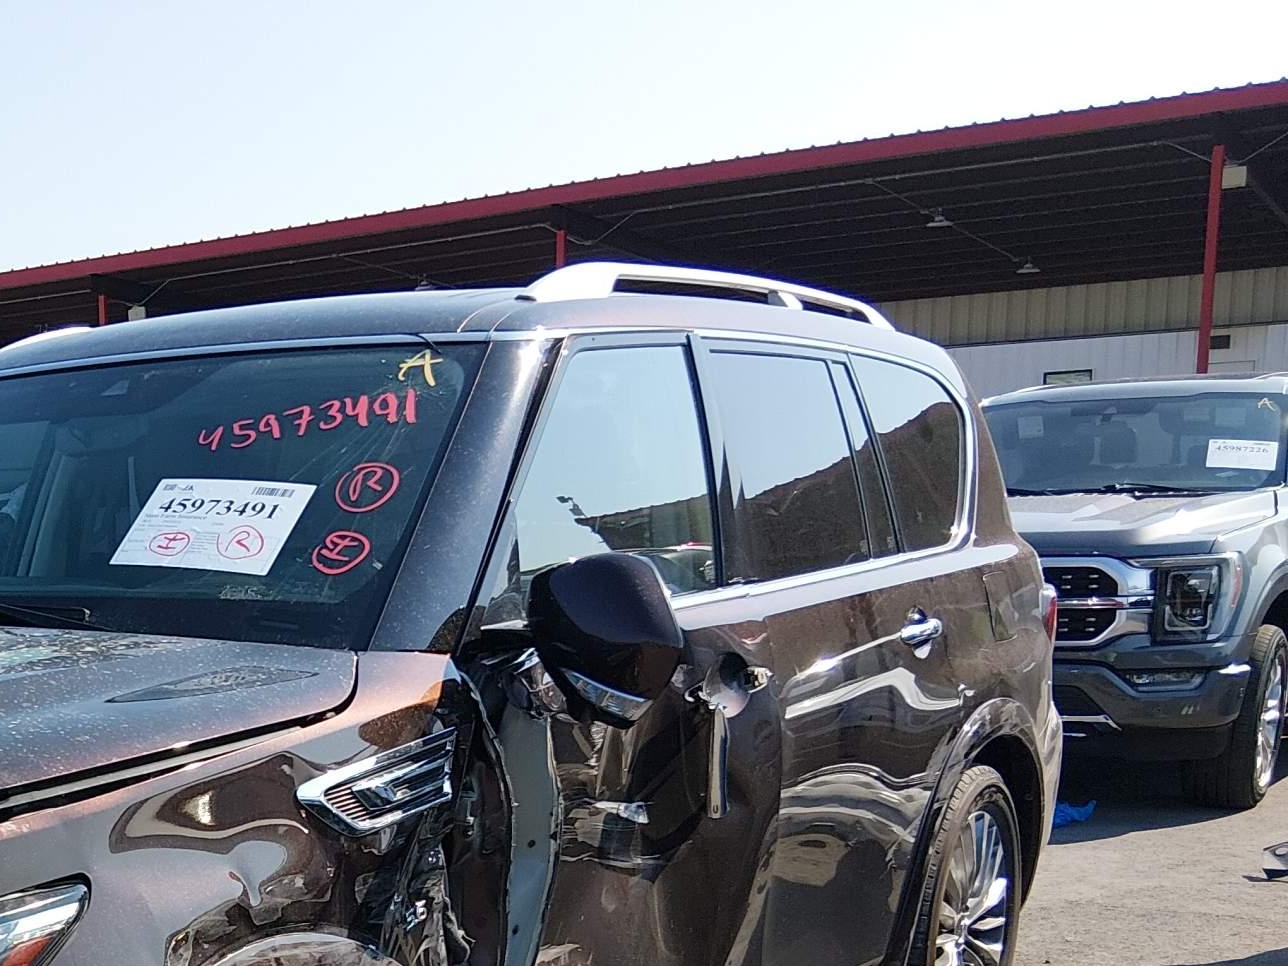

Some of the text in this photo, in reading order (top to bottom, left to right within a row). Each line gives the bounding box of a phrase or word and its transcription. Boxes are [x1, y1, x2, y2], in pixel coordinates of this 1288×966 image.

[398, 350, 444, 387] A
[198, 388, 418, 451] 45973491
[159, 497, 281, 520] 45973491
